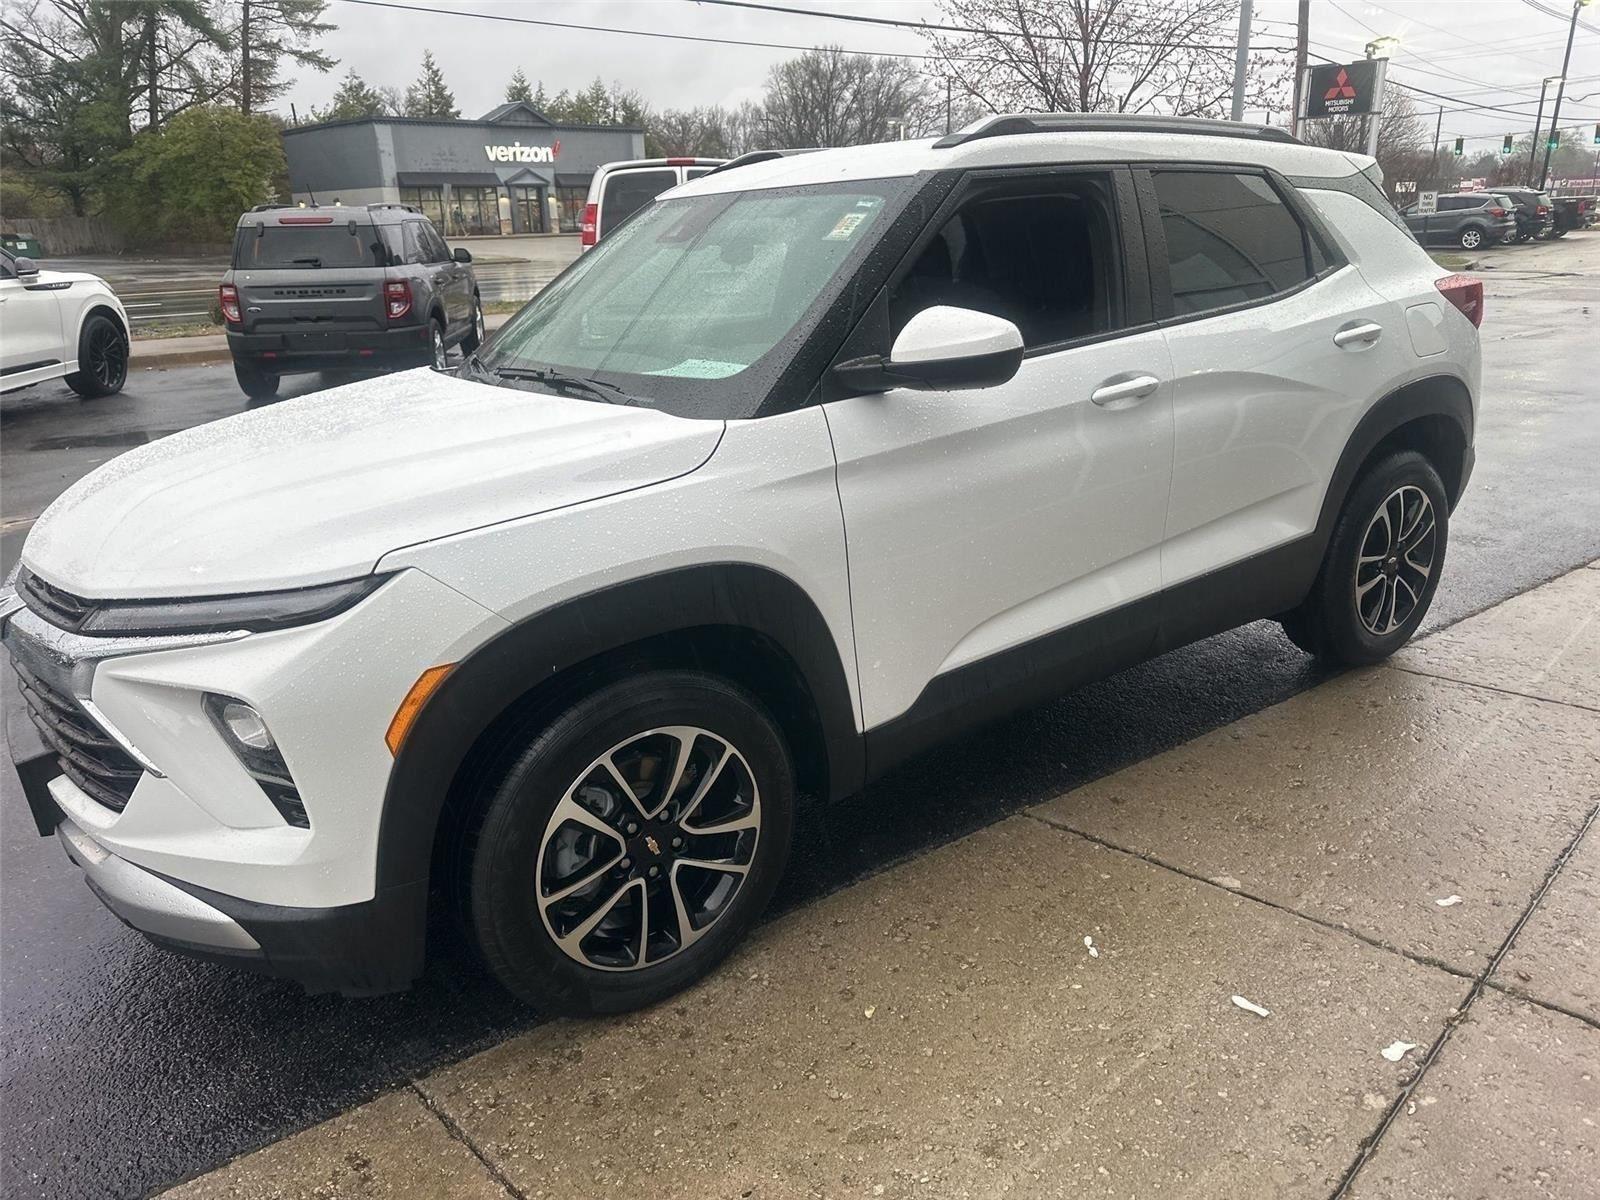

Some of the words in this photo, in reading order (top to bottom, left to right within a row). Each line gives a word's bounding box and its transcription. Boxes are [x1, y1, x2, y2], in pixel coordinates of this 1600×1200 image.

[1324, 98, 1354, 107] MITSUBISHI
[1328, 105, 1349, 113] MOTORS
[484, 141, 554, 163] verizon
[1423, 193, 1433, 201] NO
[273, 288, 347, 296] BRONCO
